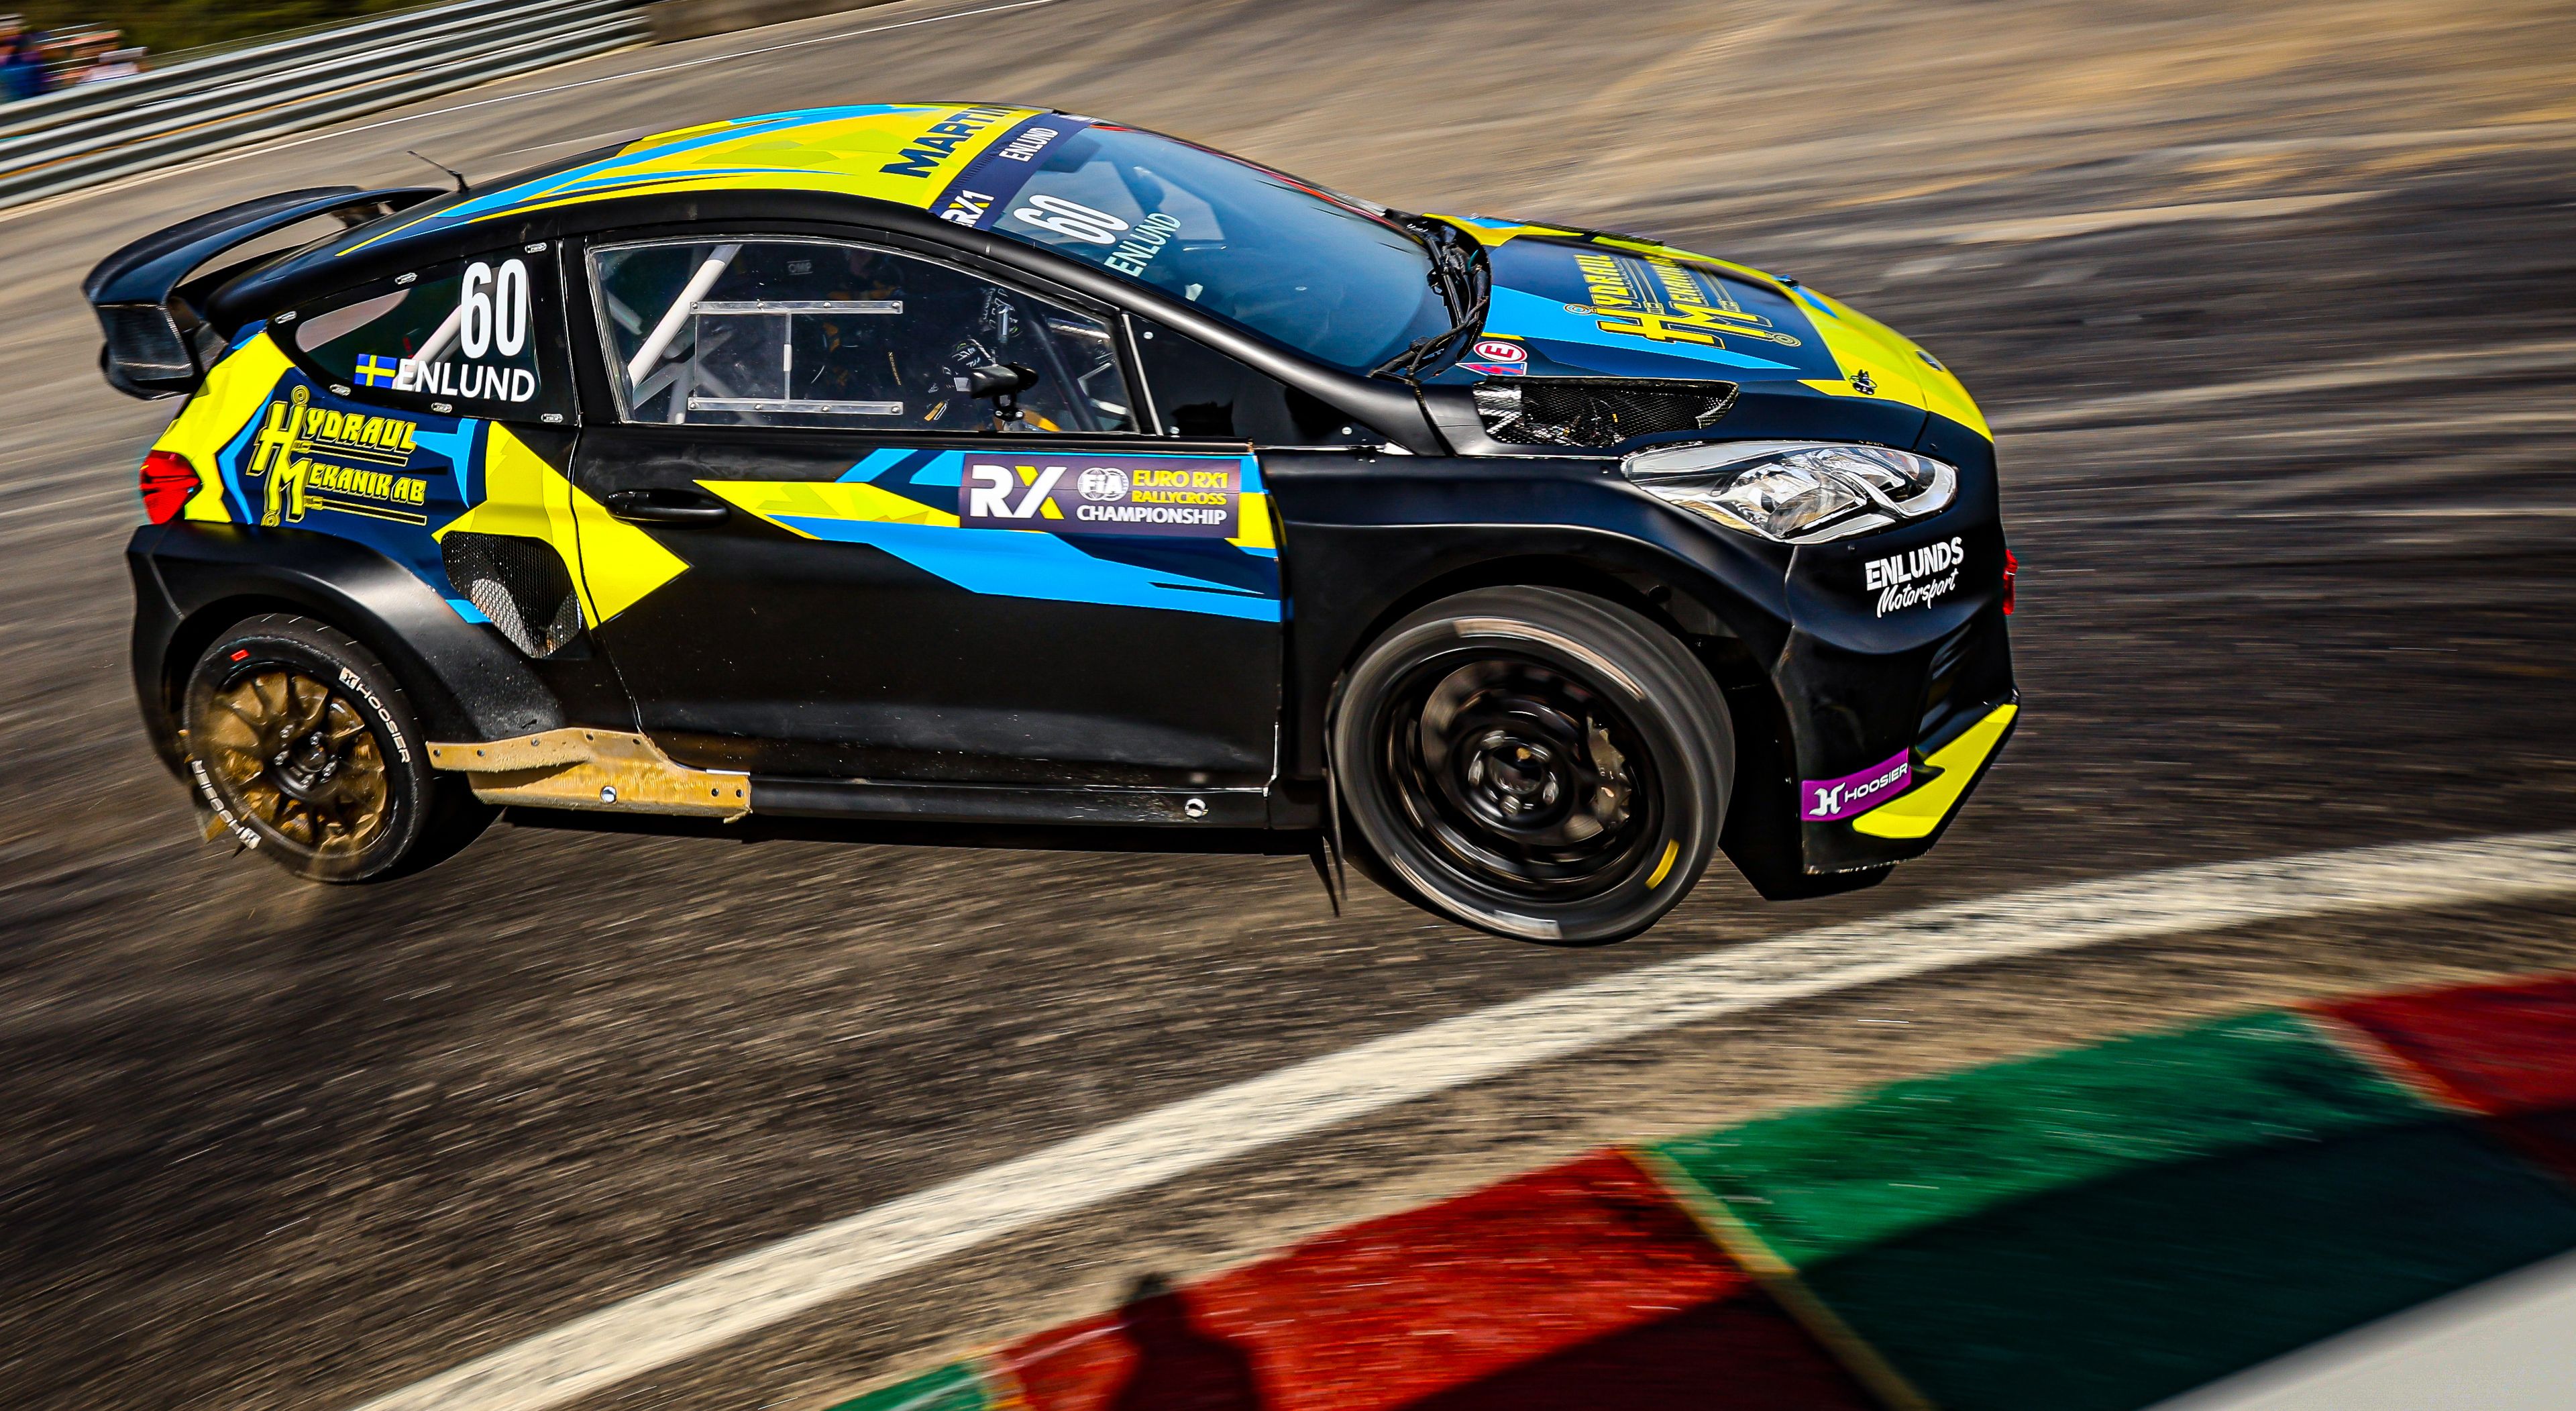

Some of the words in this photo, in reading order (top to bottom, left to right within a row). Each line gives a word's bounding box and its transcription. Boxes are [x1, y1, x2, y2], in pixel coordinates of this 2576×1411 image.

[999, 127, 1059, 162] ENLUND
[940, 189, 994, 227] RX1
[1013, 194, 1130, 245] 60
[1104, 213, 1181, 277] ENLUND
[460, 258, 527, 358] 60
[396, 358, 535, 402] ENLUND
[247, 401, 417, 476] HYDRAUL
[390, 476, 427, 506] AB
[969, 464, 1067, 519] RX
[1132, 470, 1189, 488] EURO
[1192, 472, 1228, 489] RX1
[1077, 505, 1227, 525] CHAMPIONSHIP
[1132, 491, 1227, 505] RALLYCROSS
[1865, 536, 1964, 591] ENLUNDS
[1876, 568, 1960, 618] Motorsport
[356, 683, 411, 764] HOOSIER
[1845, 762, 1909, 804] HOOSIER
